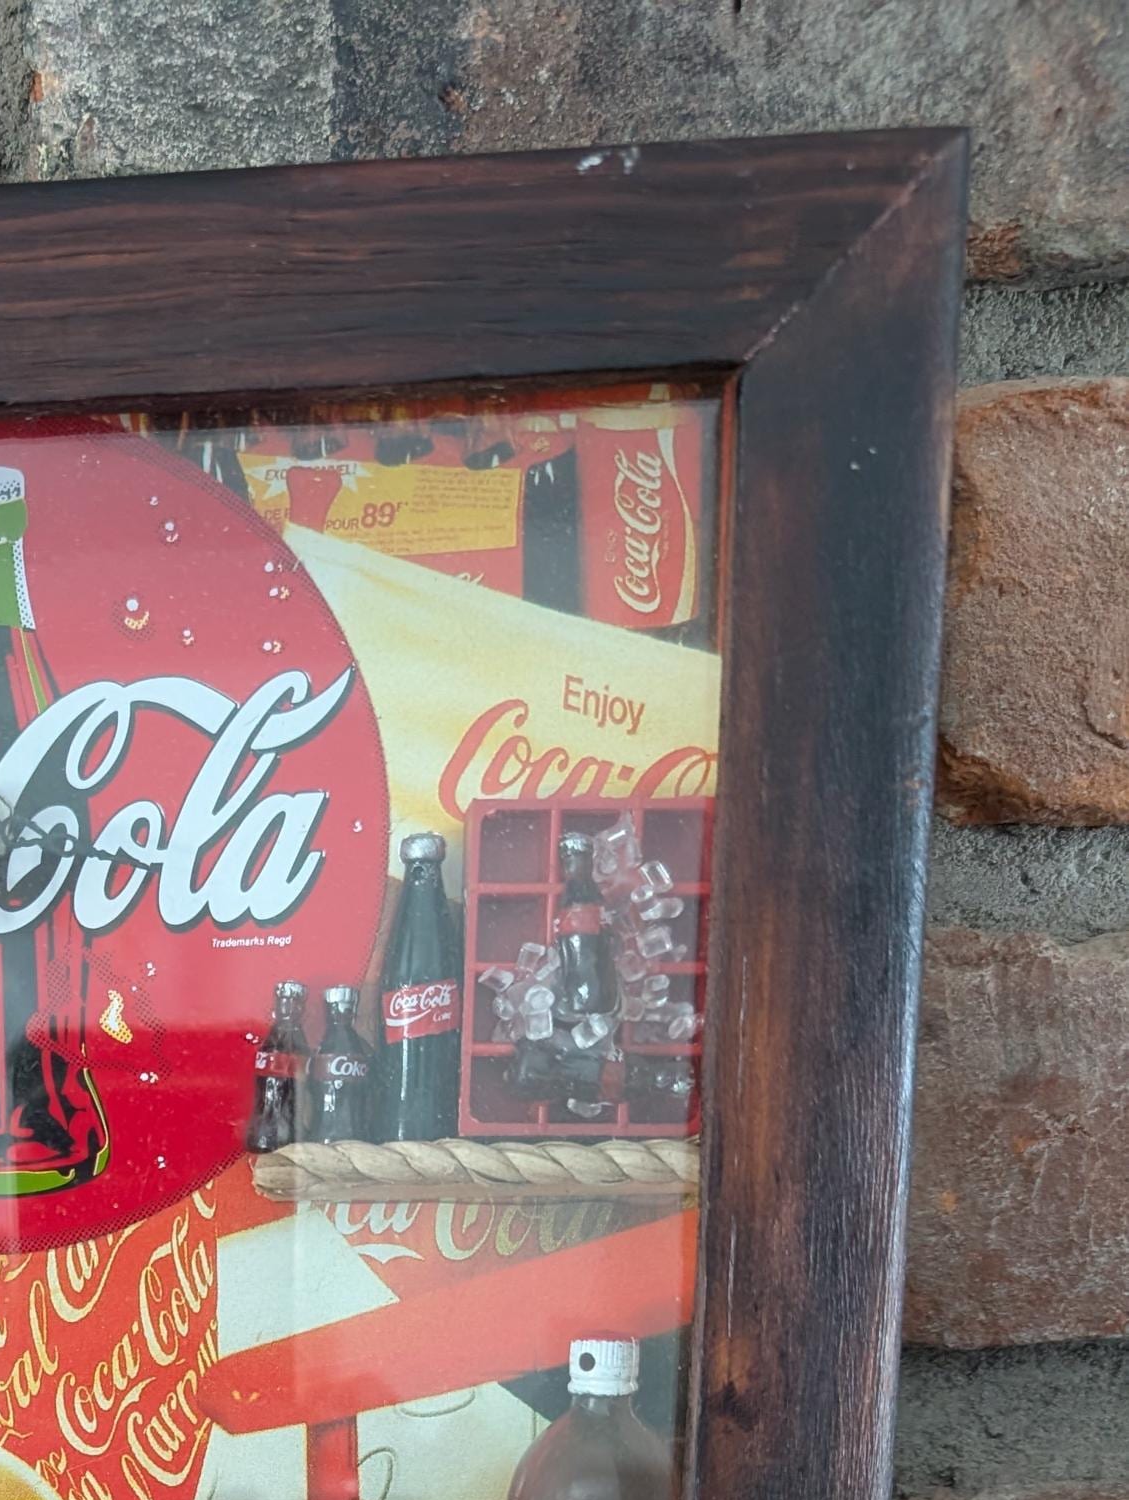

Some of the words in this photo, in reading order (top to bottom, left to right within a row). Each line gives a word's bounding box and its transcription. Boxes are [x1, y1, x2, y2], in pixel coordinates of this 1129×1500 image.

[325, 518, 360, 531] POUR
[361, 501, 395, 529] 89
[614, 448, 662, 613] Coca-Cola
[562, 674, 645, 735] Enjoy
[212, 936, 265, 949] Trademarks
[266, 934, 293, 947] Regd
[56, 1206, 214, 1456] Coca-Cola
